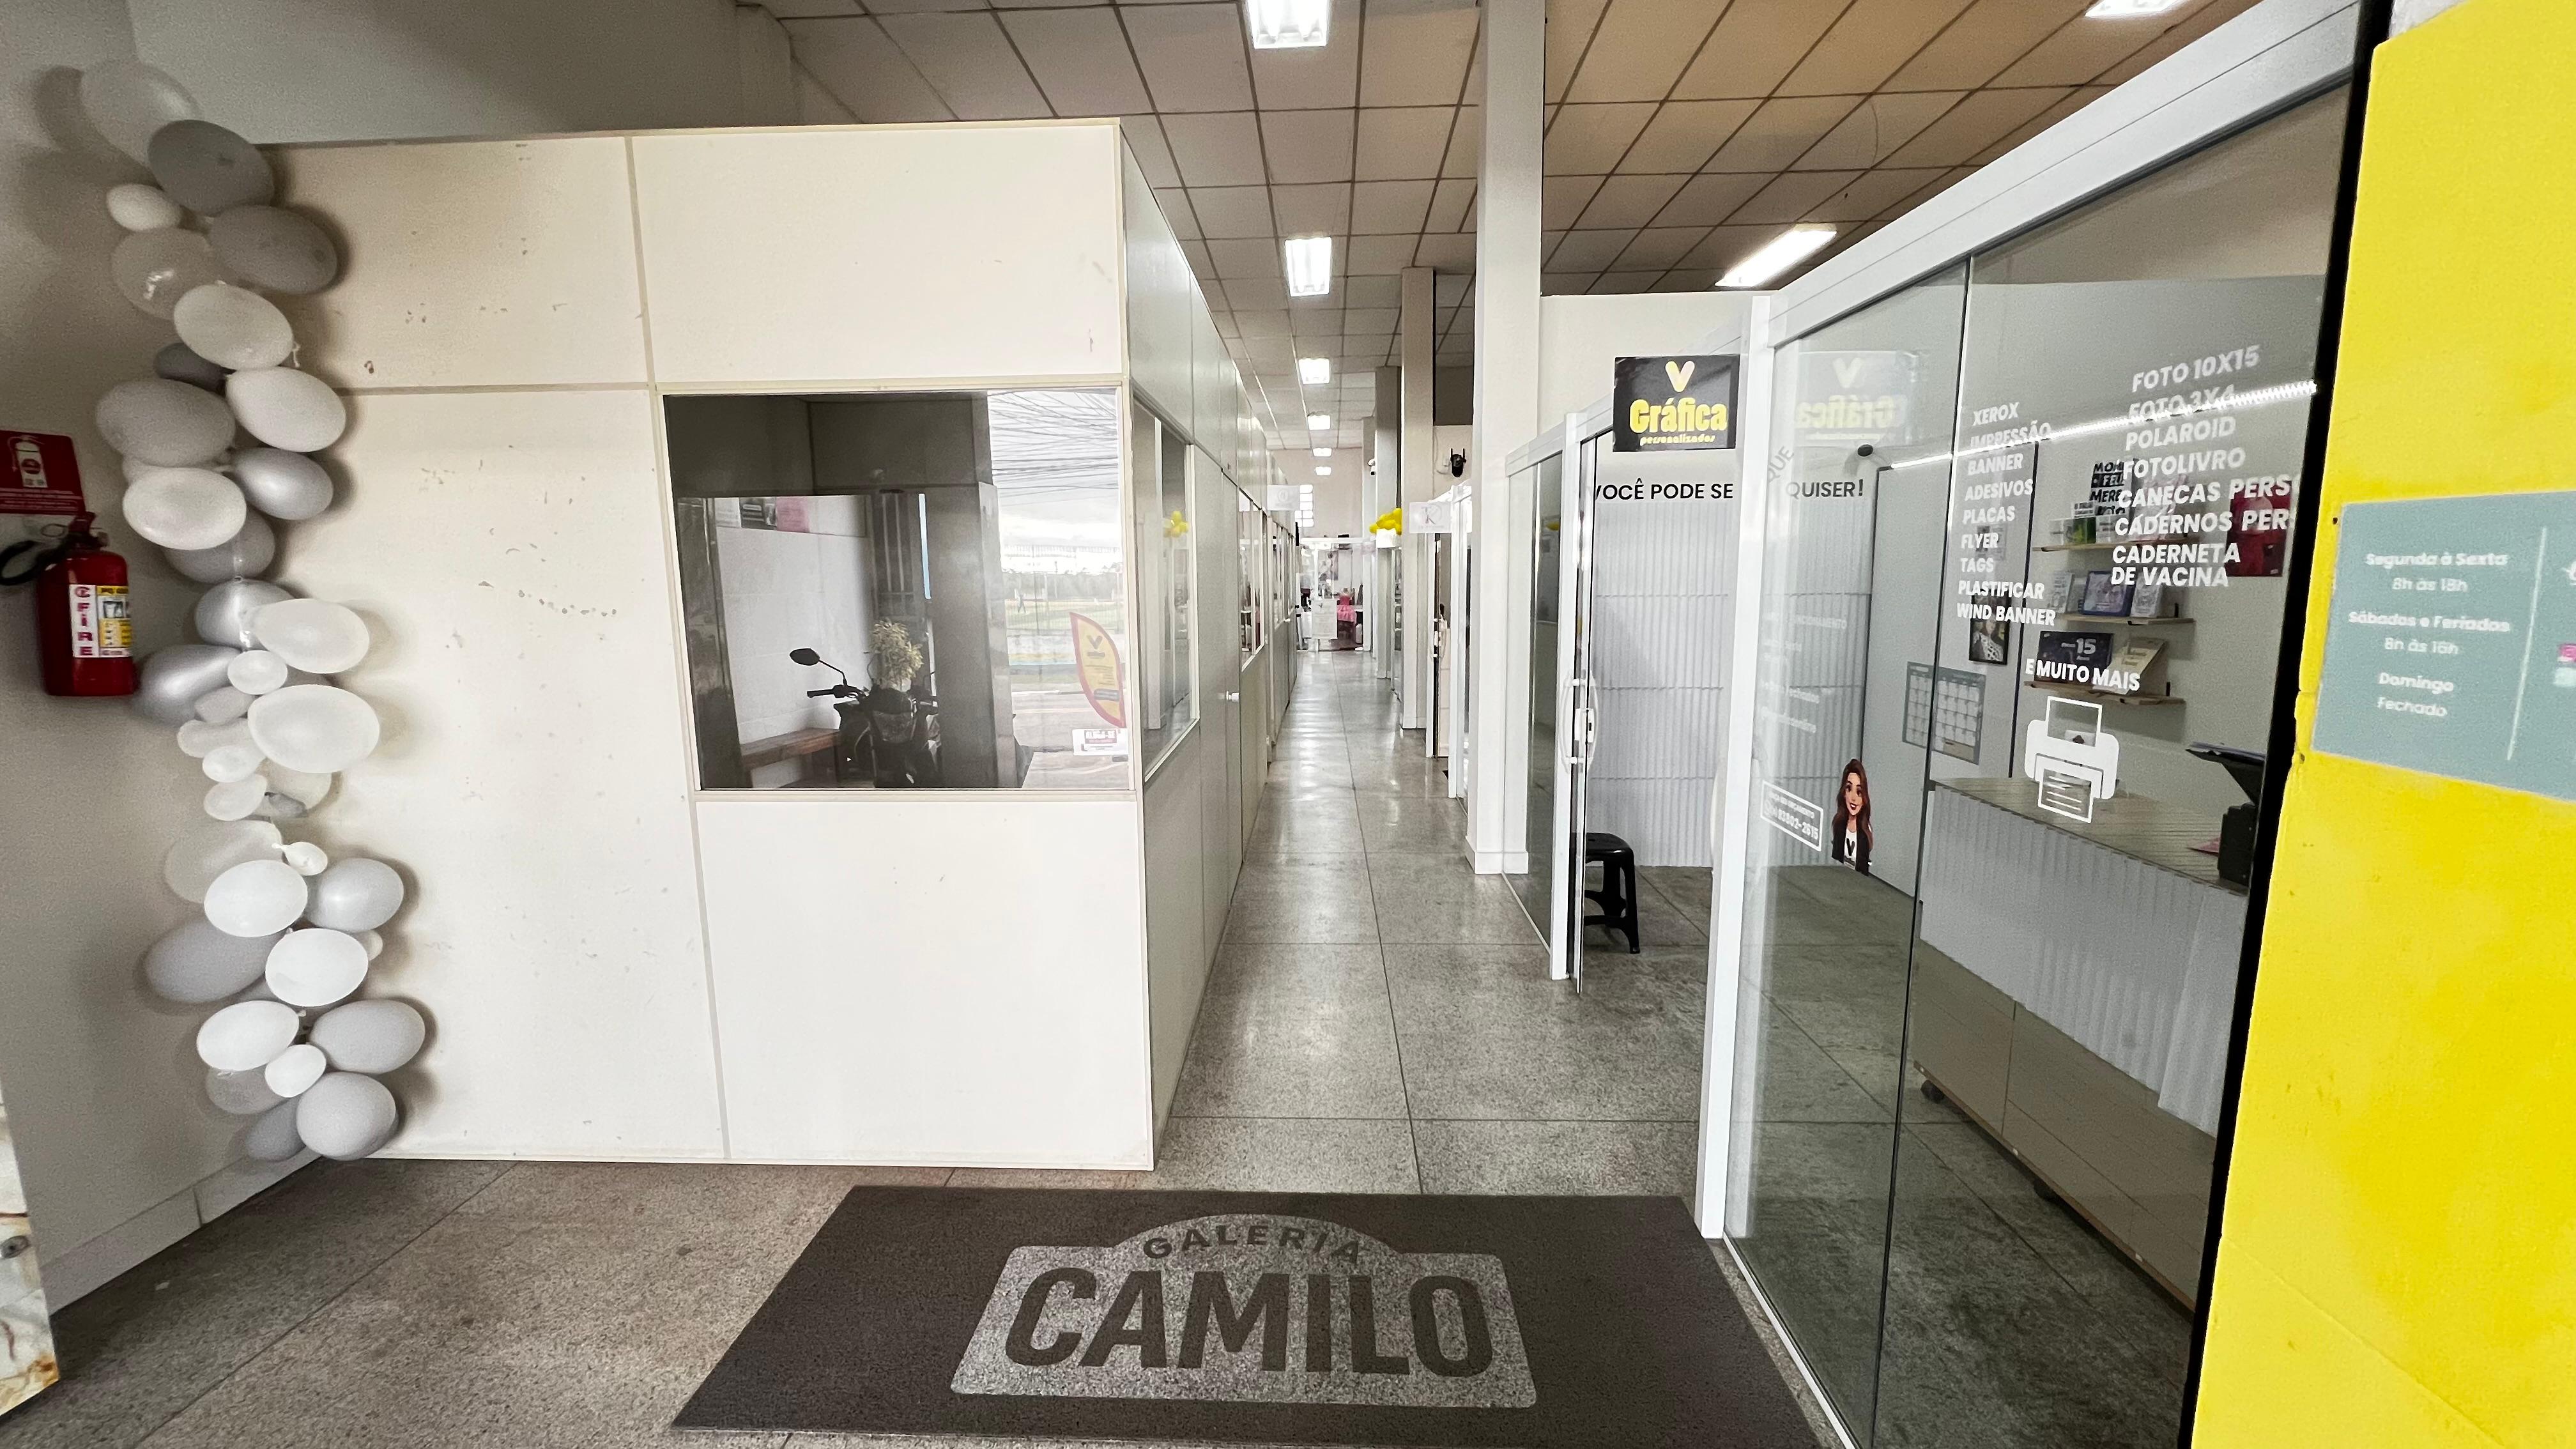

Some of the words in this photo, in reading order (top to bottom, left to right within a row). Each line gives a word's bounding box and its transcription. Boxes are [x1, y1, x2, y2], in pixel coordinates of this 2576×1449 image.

[2131, 363, 2189, 392] FOTO
[2193, 344, 2260, 379] 10X15
[1629, 397, 1728, 433] Gráfica
[1972, 402, 2019, 426] XEROX
[2129, 394, 2186, 418] FOTO
[1970, 420, 2051, 447] IMPRESSÃO
[2126, 416, 2236, 450] POLAROID
[1967, 454, 2023, 476] BANNER
[2124, 447, 2246, 479] FOTOLIVRO
[1651, 483, 1705, 499] PODE
[1786, 479, 1864, 500] QUISER!
[1965, 479, 2034, 501] ADESIVOS
[2118, 481, 2221, 508] CANECAS
[1962, 505, 2015, 525] PLACAS
[2115, 511, 2233, 535] CADERNOS
[1961, 532, 1999, 549] FLYER
[2112, 542, 2241, 564] CADERNETA
[2365, 553, 2437, 569] Segunda
[2455, 553, 2508, 565] Sexta
[1960, 558, 1994, 572] TAGS
[2111, 567, 2136, 585] DE
[2143, 567, 2228, 586] VACINA
[2392, 578, 2413, 590] 8h
[1958, 580, 2045, 599] PLASTIFICAR
[1957, 602, 1992, 620] WIND
[1996, 606, 2056, 626] BANNER
[2349, 611, 2416, 626] Sábados
[2419, 617, 2430, 627] e
[2434, 615, 2510, 632] Feriados
[2077, 638, 2096, 654] 15
[2384, 637, 2404, 650] 8h
[2025, 658, 2035, 675] E
[2036, 659, 2089, 683] MUITO
[2092, 668, 2140, 691] MAIS
[2378, 672, 2454, 694] Domingo
[2377, 696, 2448, 717] Fechado
[1144, 1224, 1364, 1264] GALERIA
[1005, 1267, 1494, 1377] CAMILO
